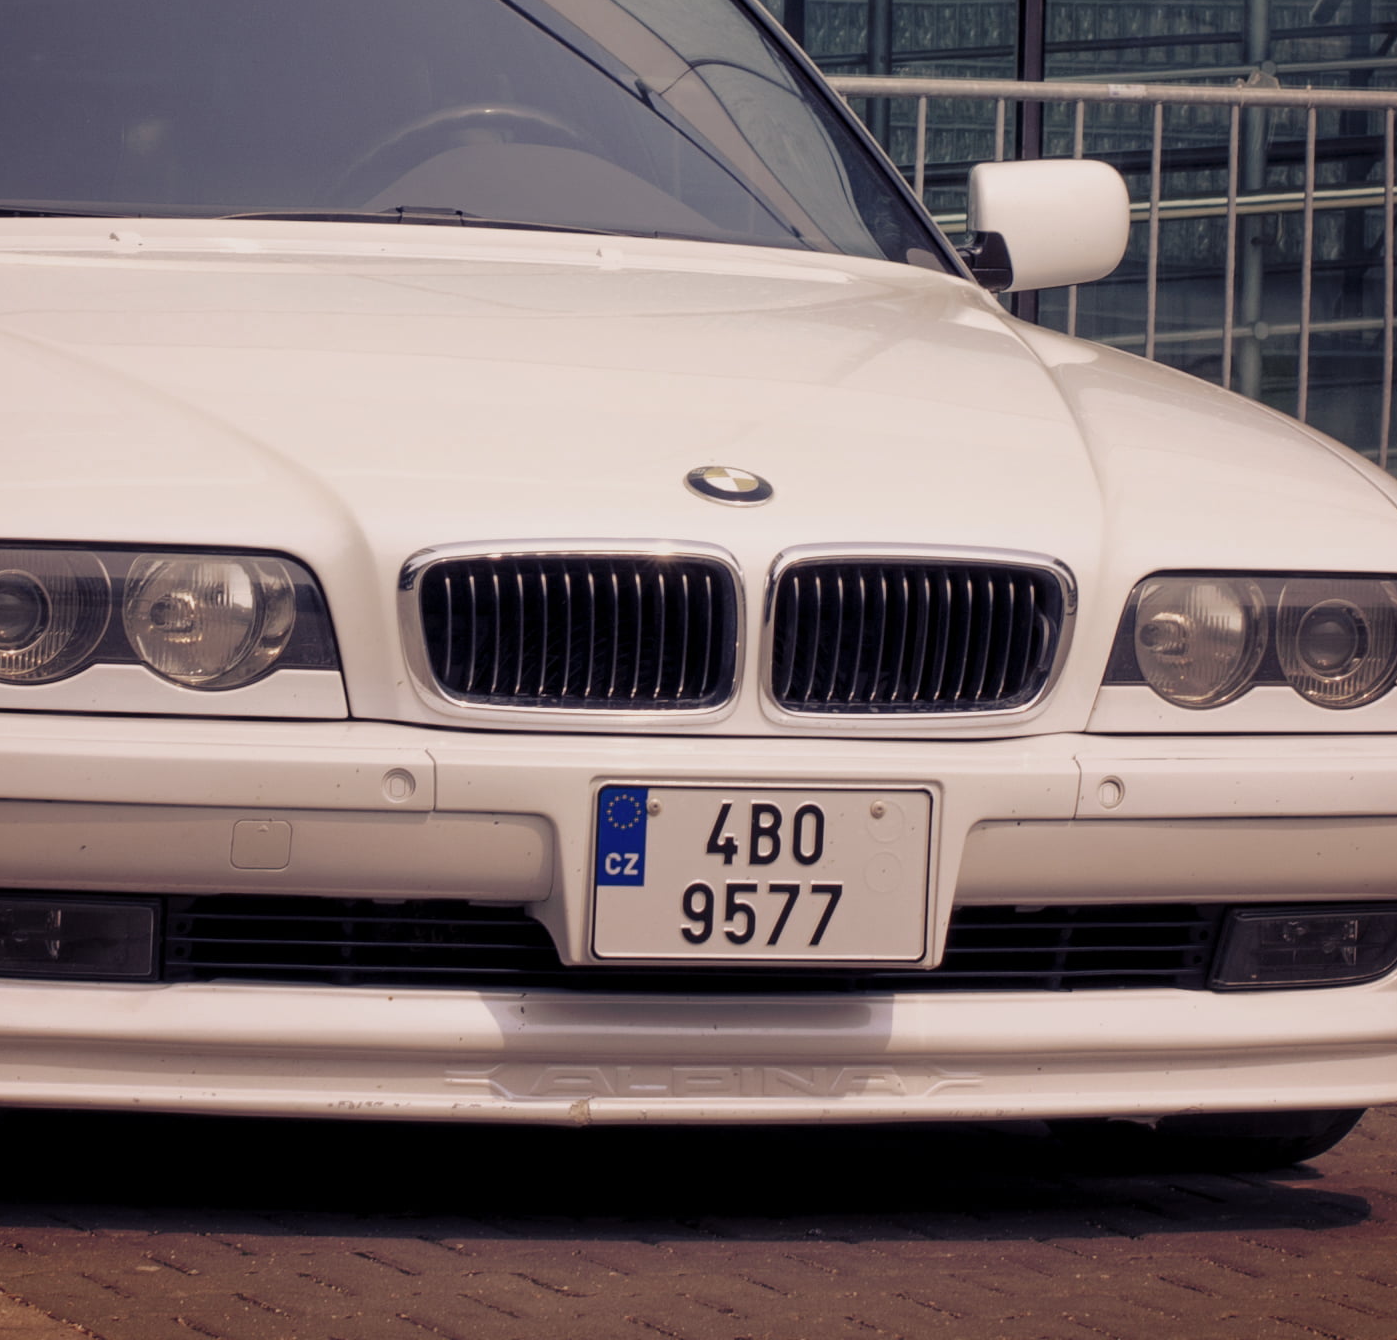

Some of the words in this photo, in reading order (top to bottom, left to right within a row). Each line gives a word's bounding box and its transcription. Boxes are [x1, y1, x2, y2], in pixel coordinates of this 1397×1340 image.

[705, 800, 826, 866] 4B0
[604, 851, 640, 877] CZ
[680, 880, 845, 947] 9577
[530, 1064, 907, 1097] ALPINA
